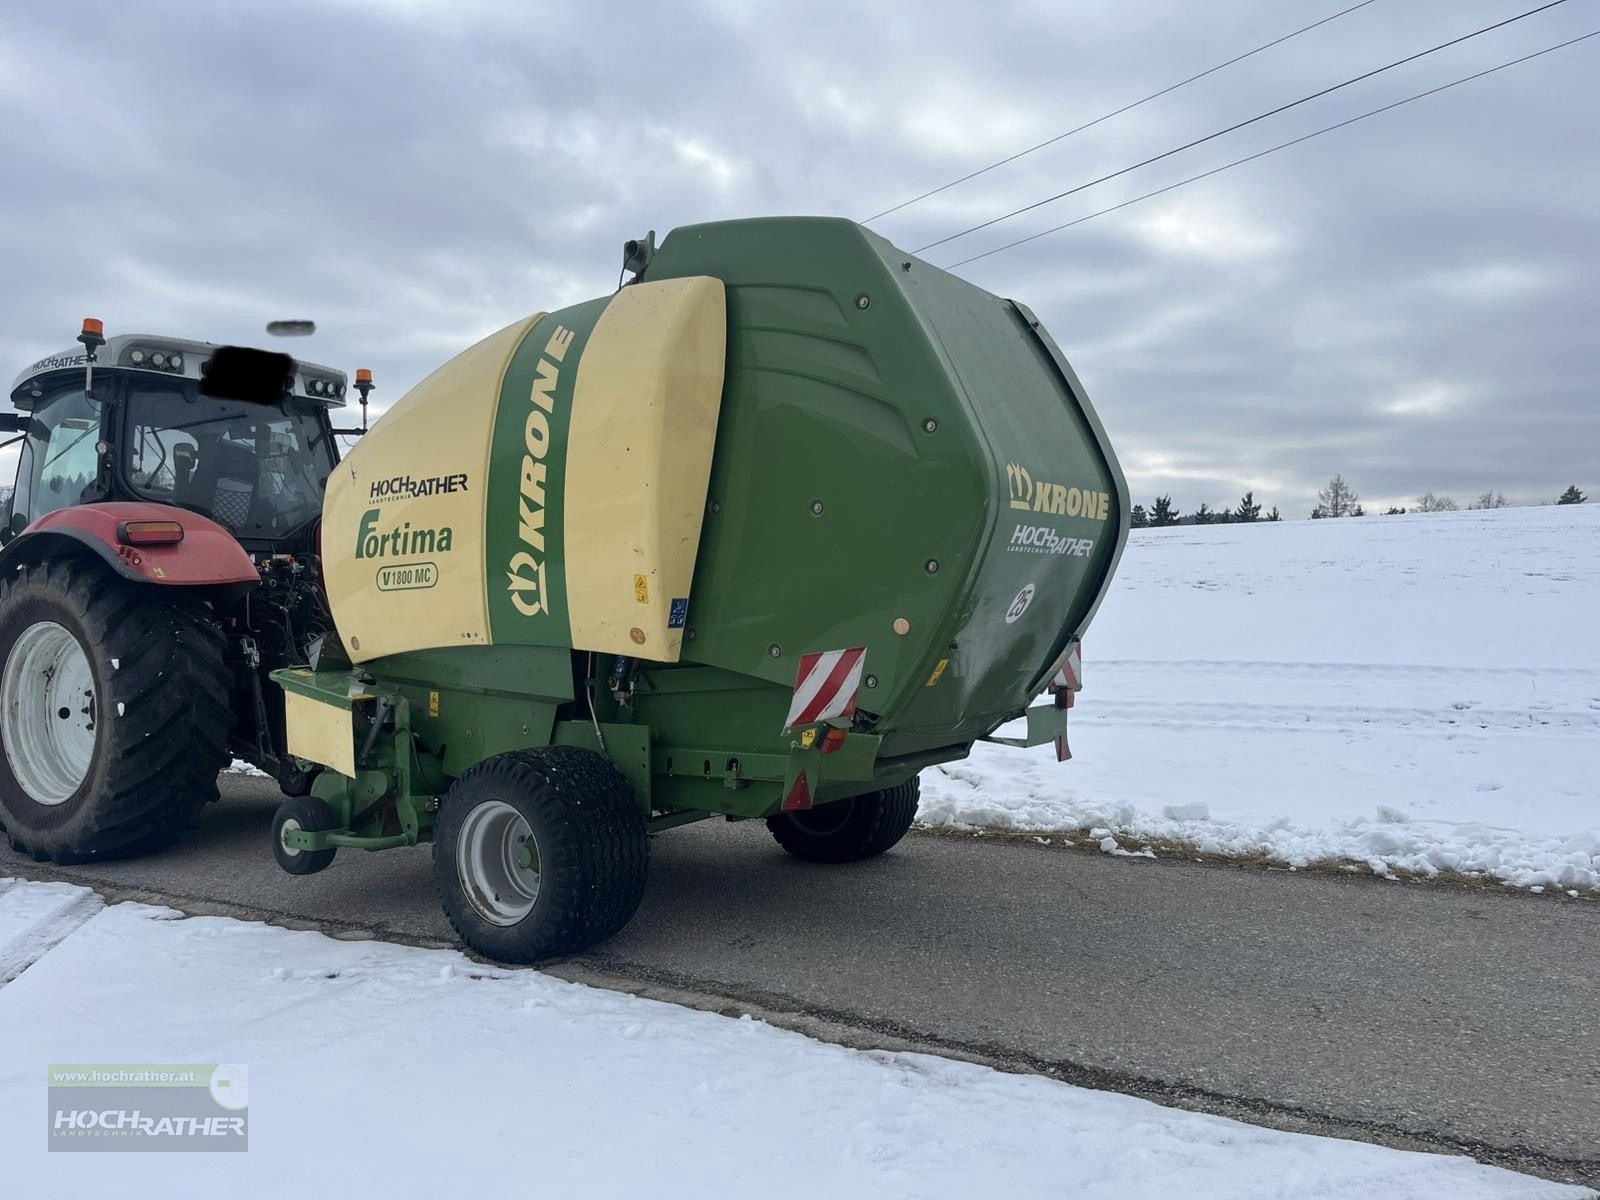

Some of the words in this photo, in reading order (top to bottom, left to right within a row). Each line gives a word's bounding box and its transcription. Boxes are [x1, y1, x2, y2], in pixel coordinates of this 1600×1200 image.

[32, 355, 97, 372] HOCHRATHE
[519, 325, 575, 552] KRONE
[369, 473, 469, 498] HOCHRATHER
[1033, 481, 1110, 521] KRONE
[355, 508, 453, 559] Fortima
[1010, 524, 1094, 557] HOCHRATHER
[415, 567, 431, 584] MC
[1008, 589, 1032, 617] 25
